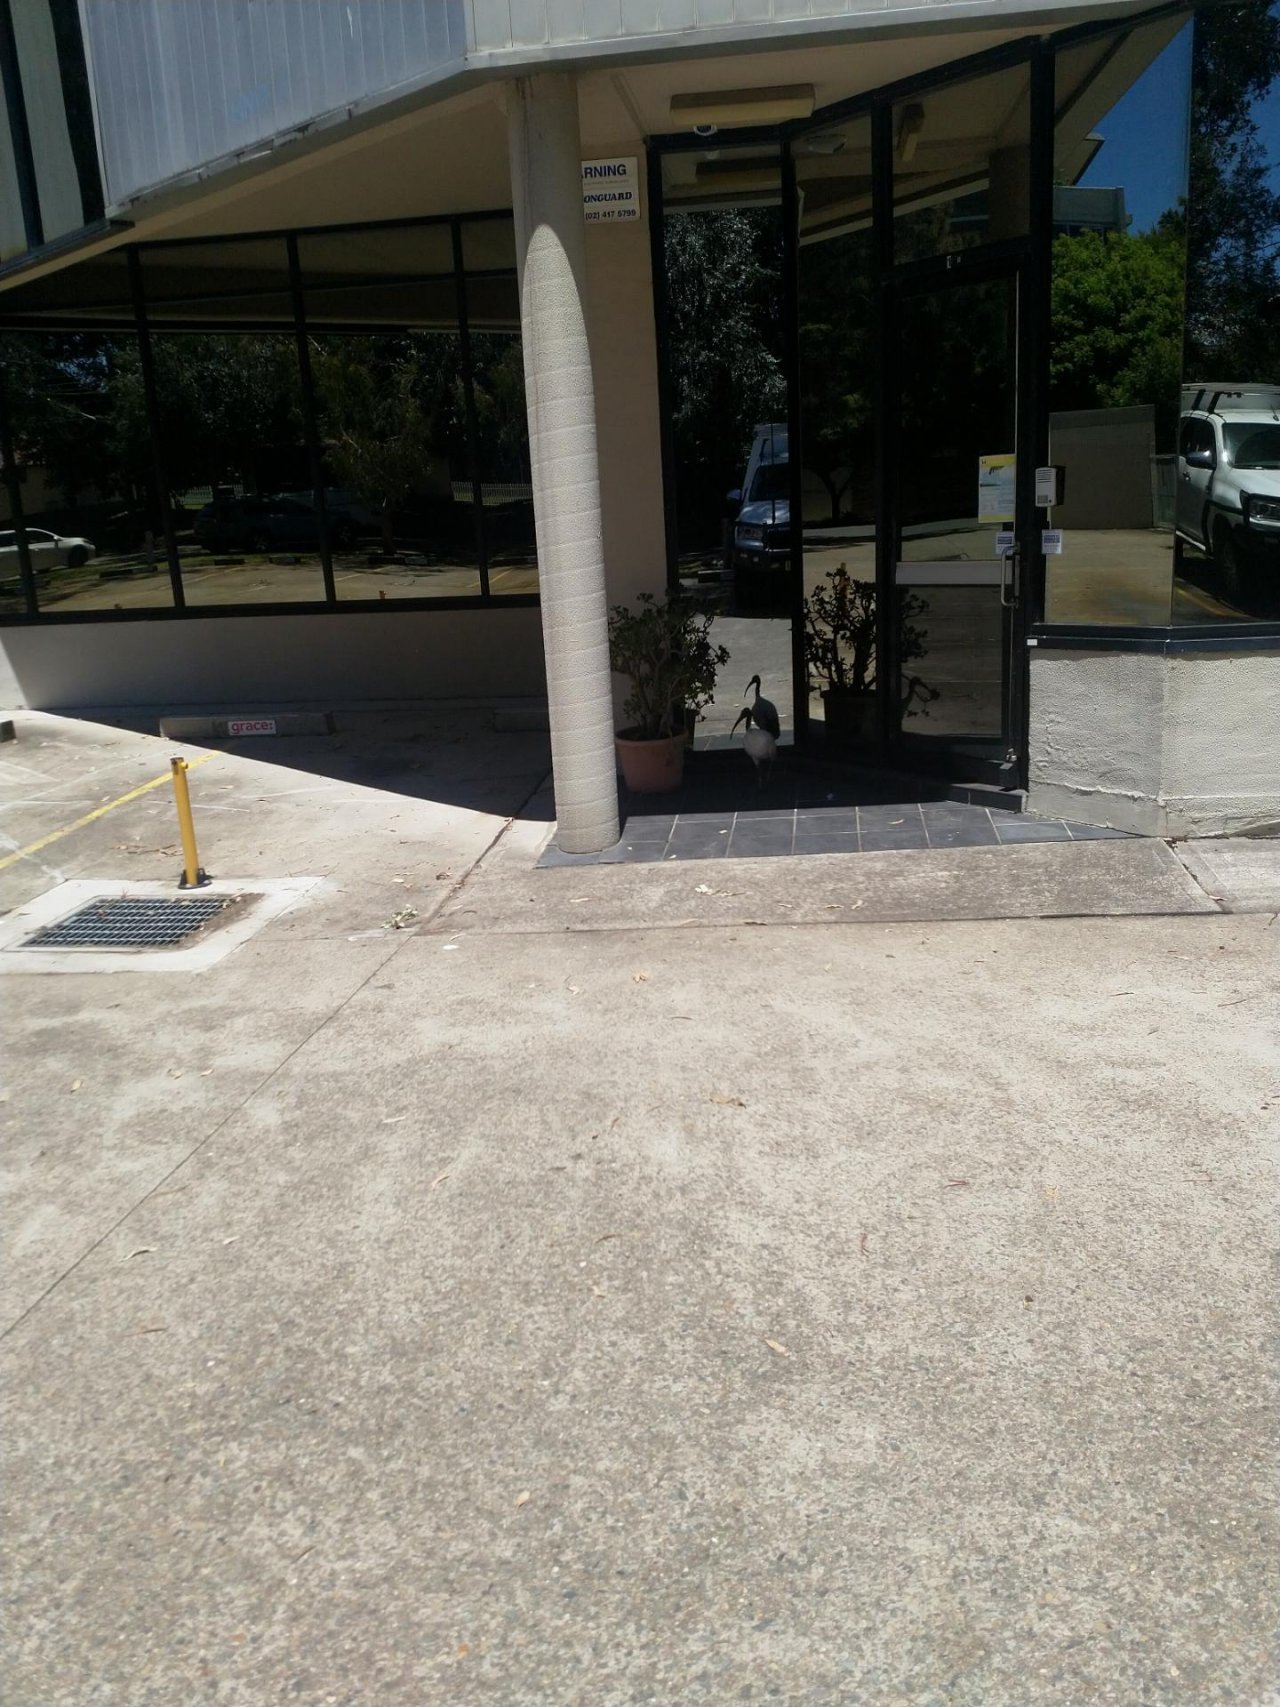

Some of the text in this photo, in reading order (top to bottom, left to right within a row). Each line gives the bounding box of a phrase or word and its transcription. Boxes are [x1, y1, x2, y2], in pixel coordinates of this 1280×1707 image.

[581, 164, 627, 178] RNING
[585, 212, 600, 220] (02)
[602, 210, 615, 218] 417
